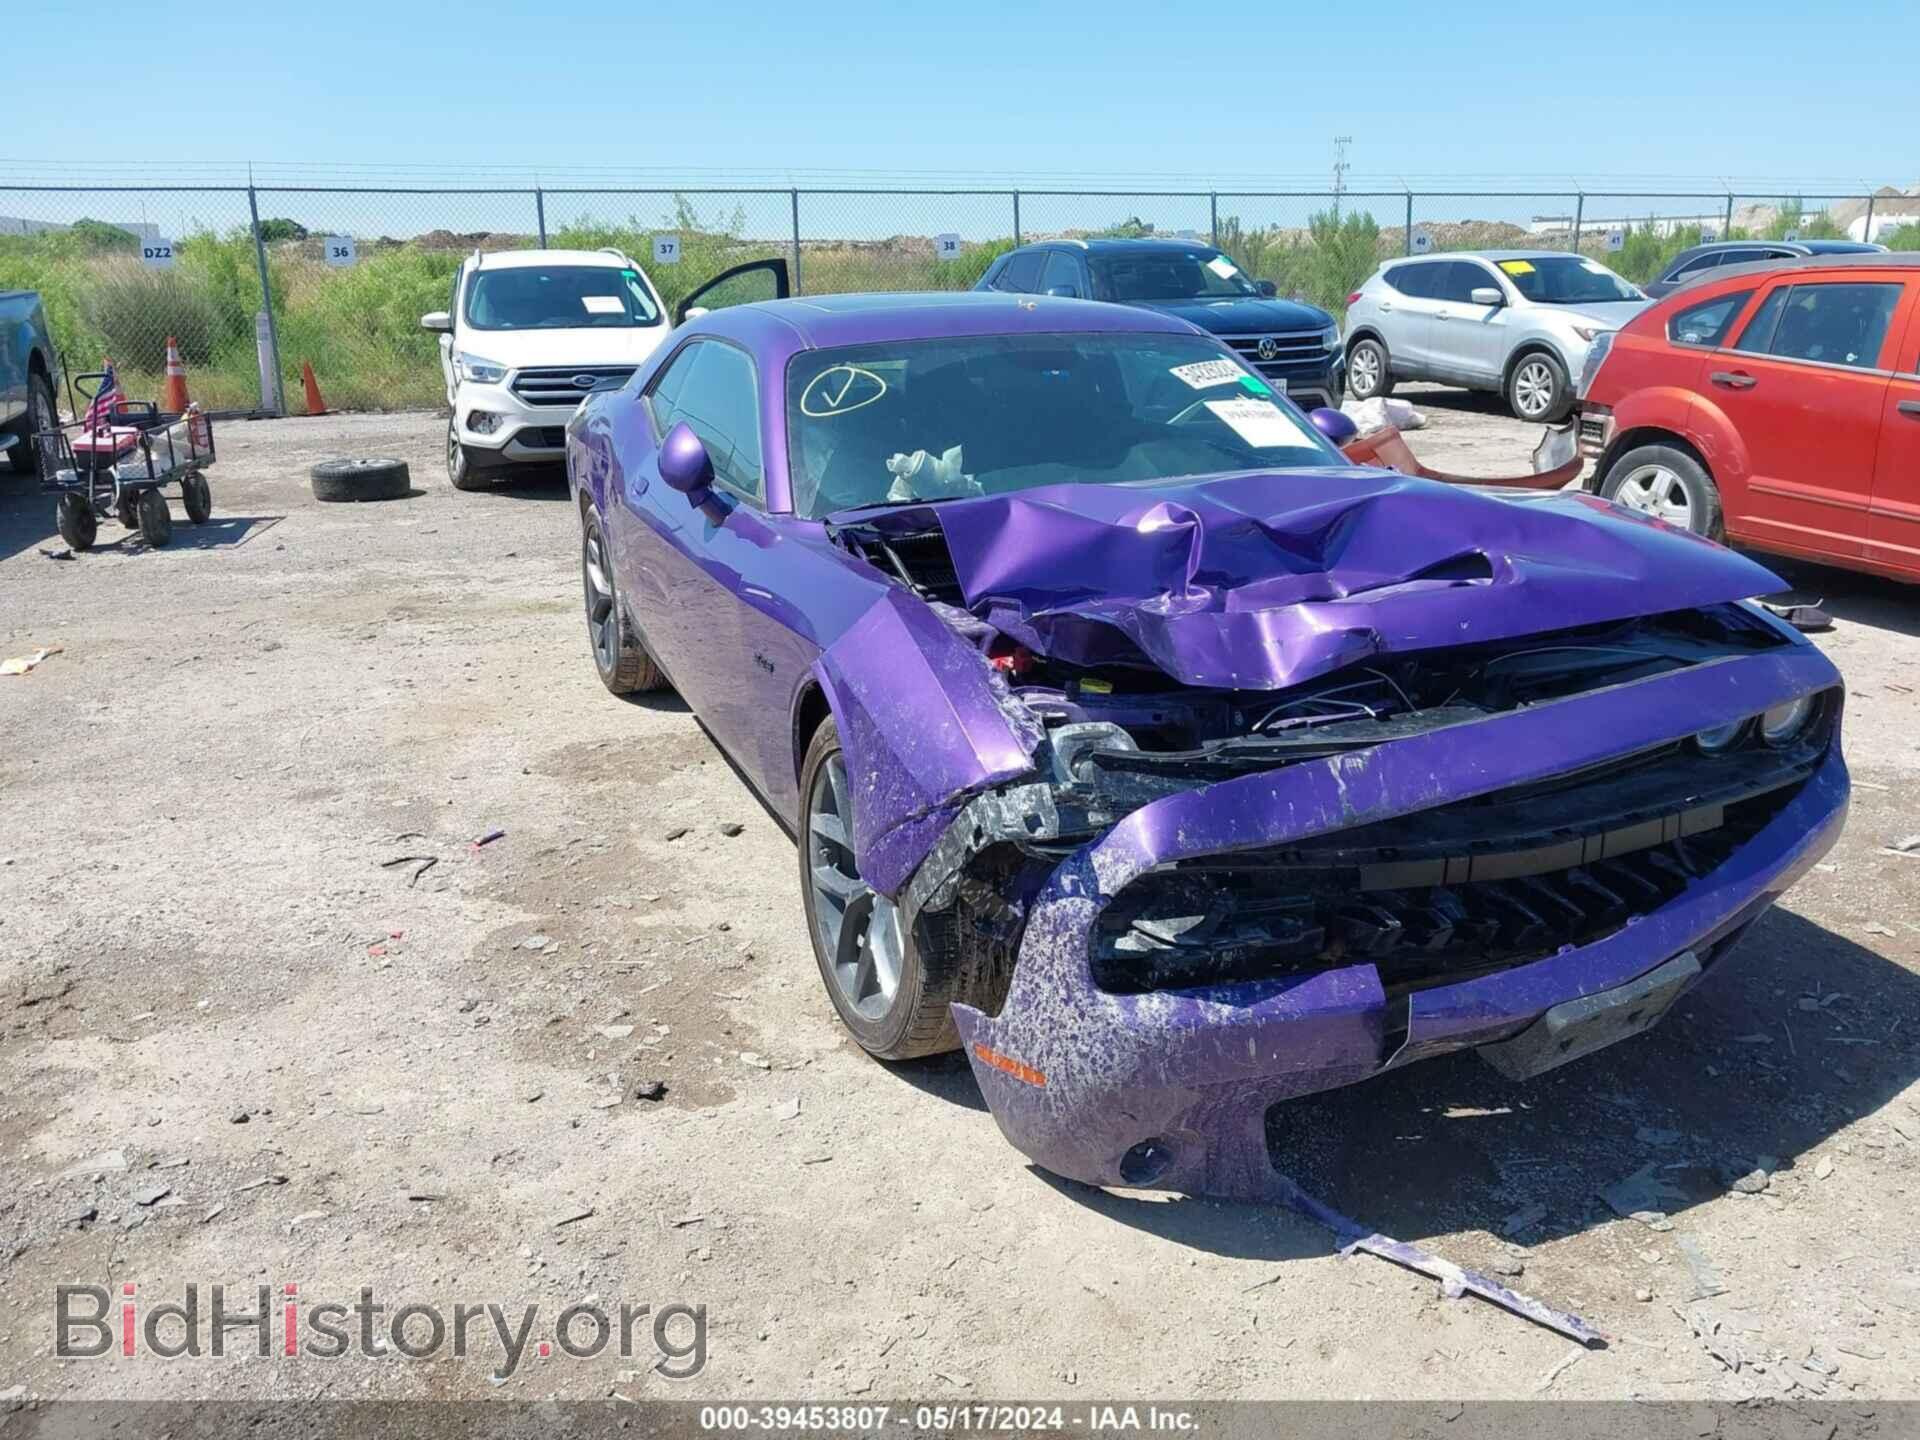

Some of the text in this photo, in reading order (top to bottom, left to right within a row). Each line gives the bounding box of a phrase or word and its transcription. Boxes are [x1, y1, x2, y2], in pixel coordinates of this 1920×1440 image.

[660, 244, 674, 254] 37
[943, 240, 955, 251] 38
[144, 247, 172, 259] DZ2
[332, 247, 349, 258] 36
